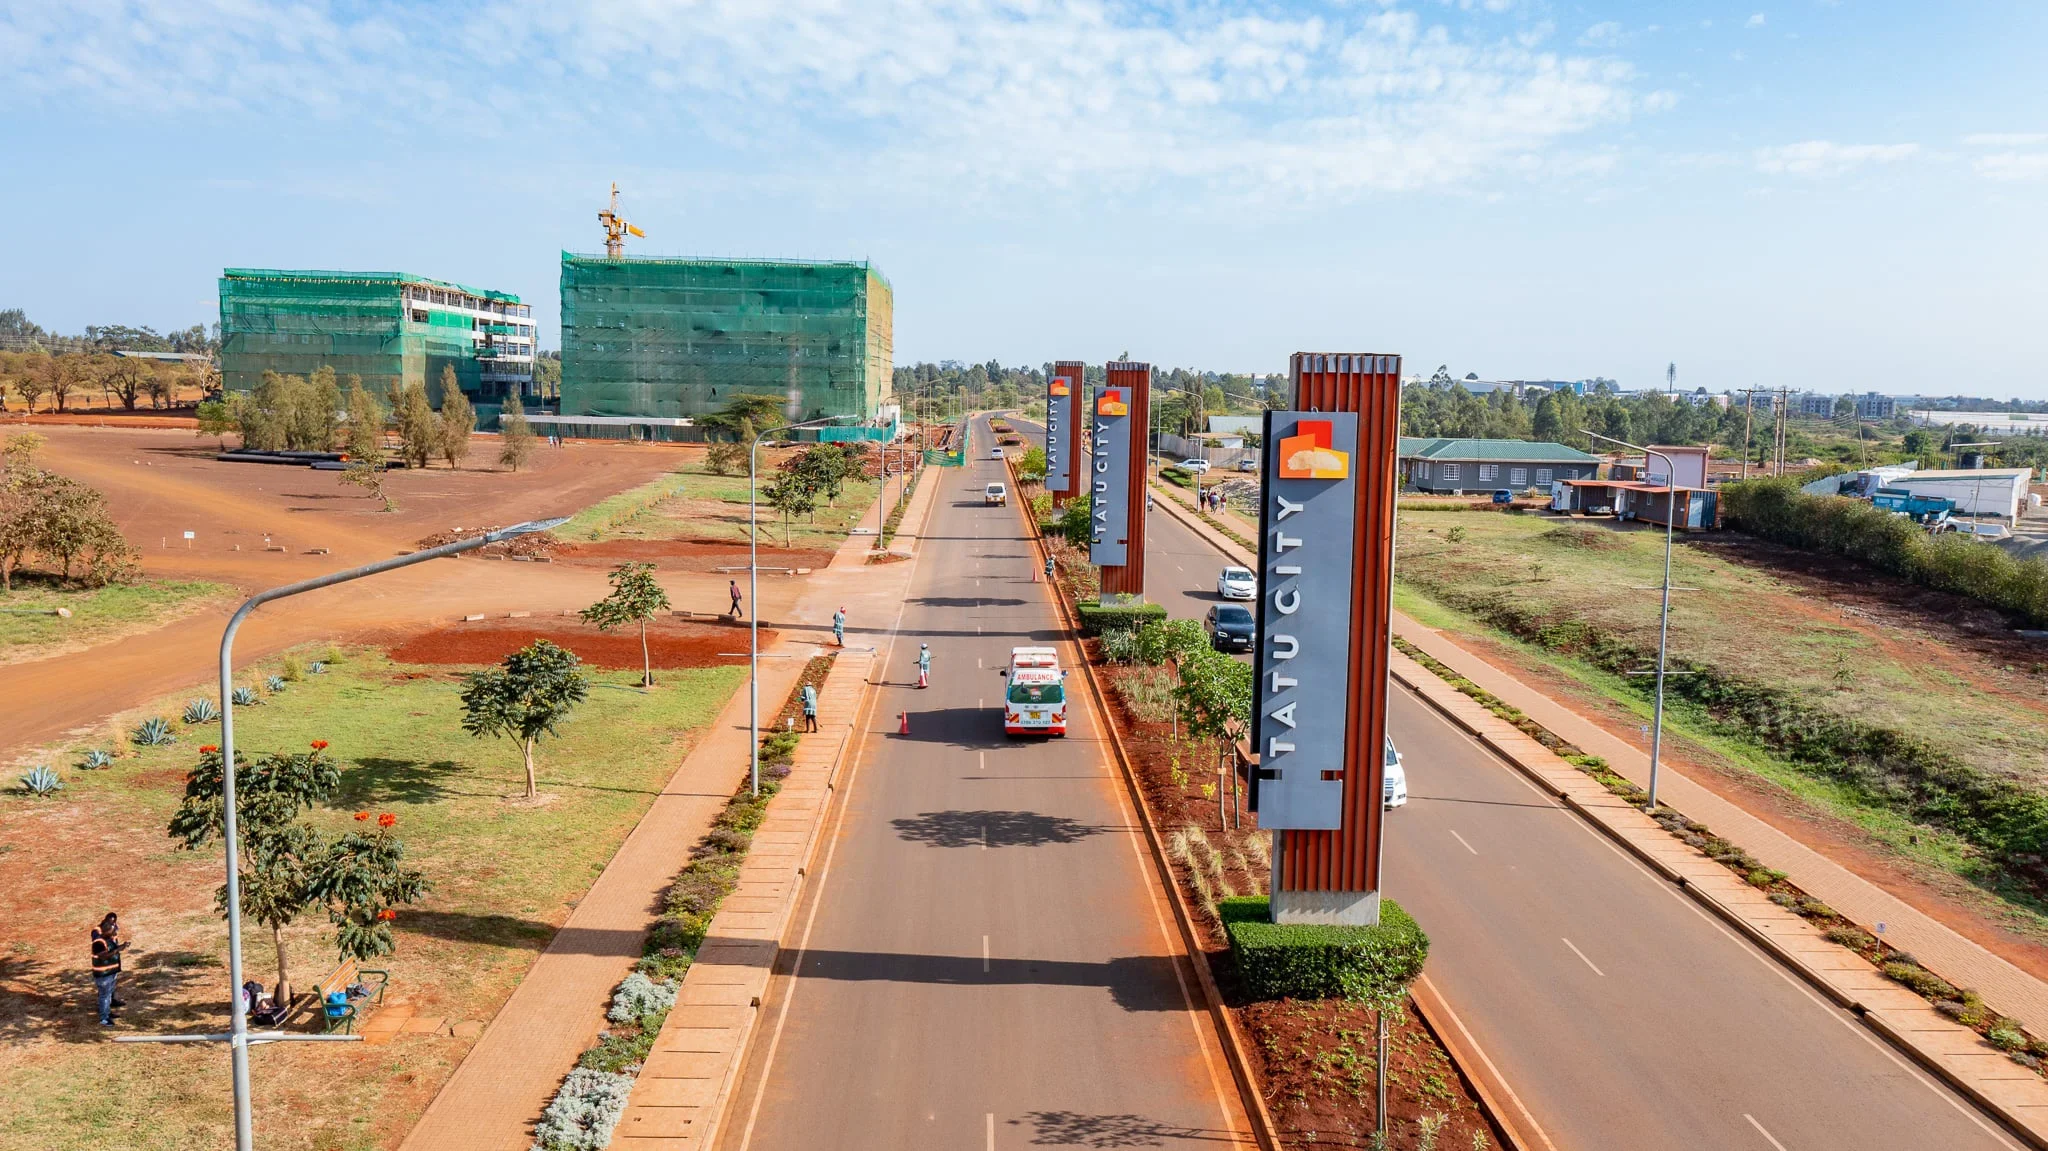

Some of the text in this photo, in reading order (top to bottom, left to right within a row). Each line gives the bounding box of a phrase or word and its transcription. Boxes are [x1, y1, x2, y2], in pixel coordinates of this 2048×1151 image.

[1049, 399, 1058, 471] TATU CITY
[1095, 422, 1109, 534] TATU CITY
[1269, 495, 1304, 757] TATU CITY
